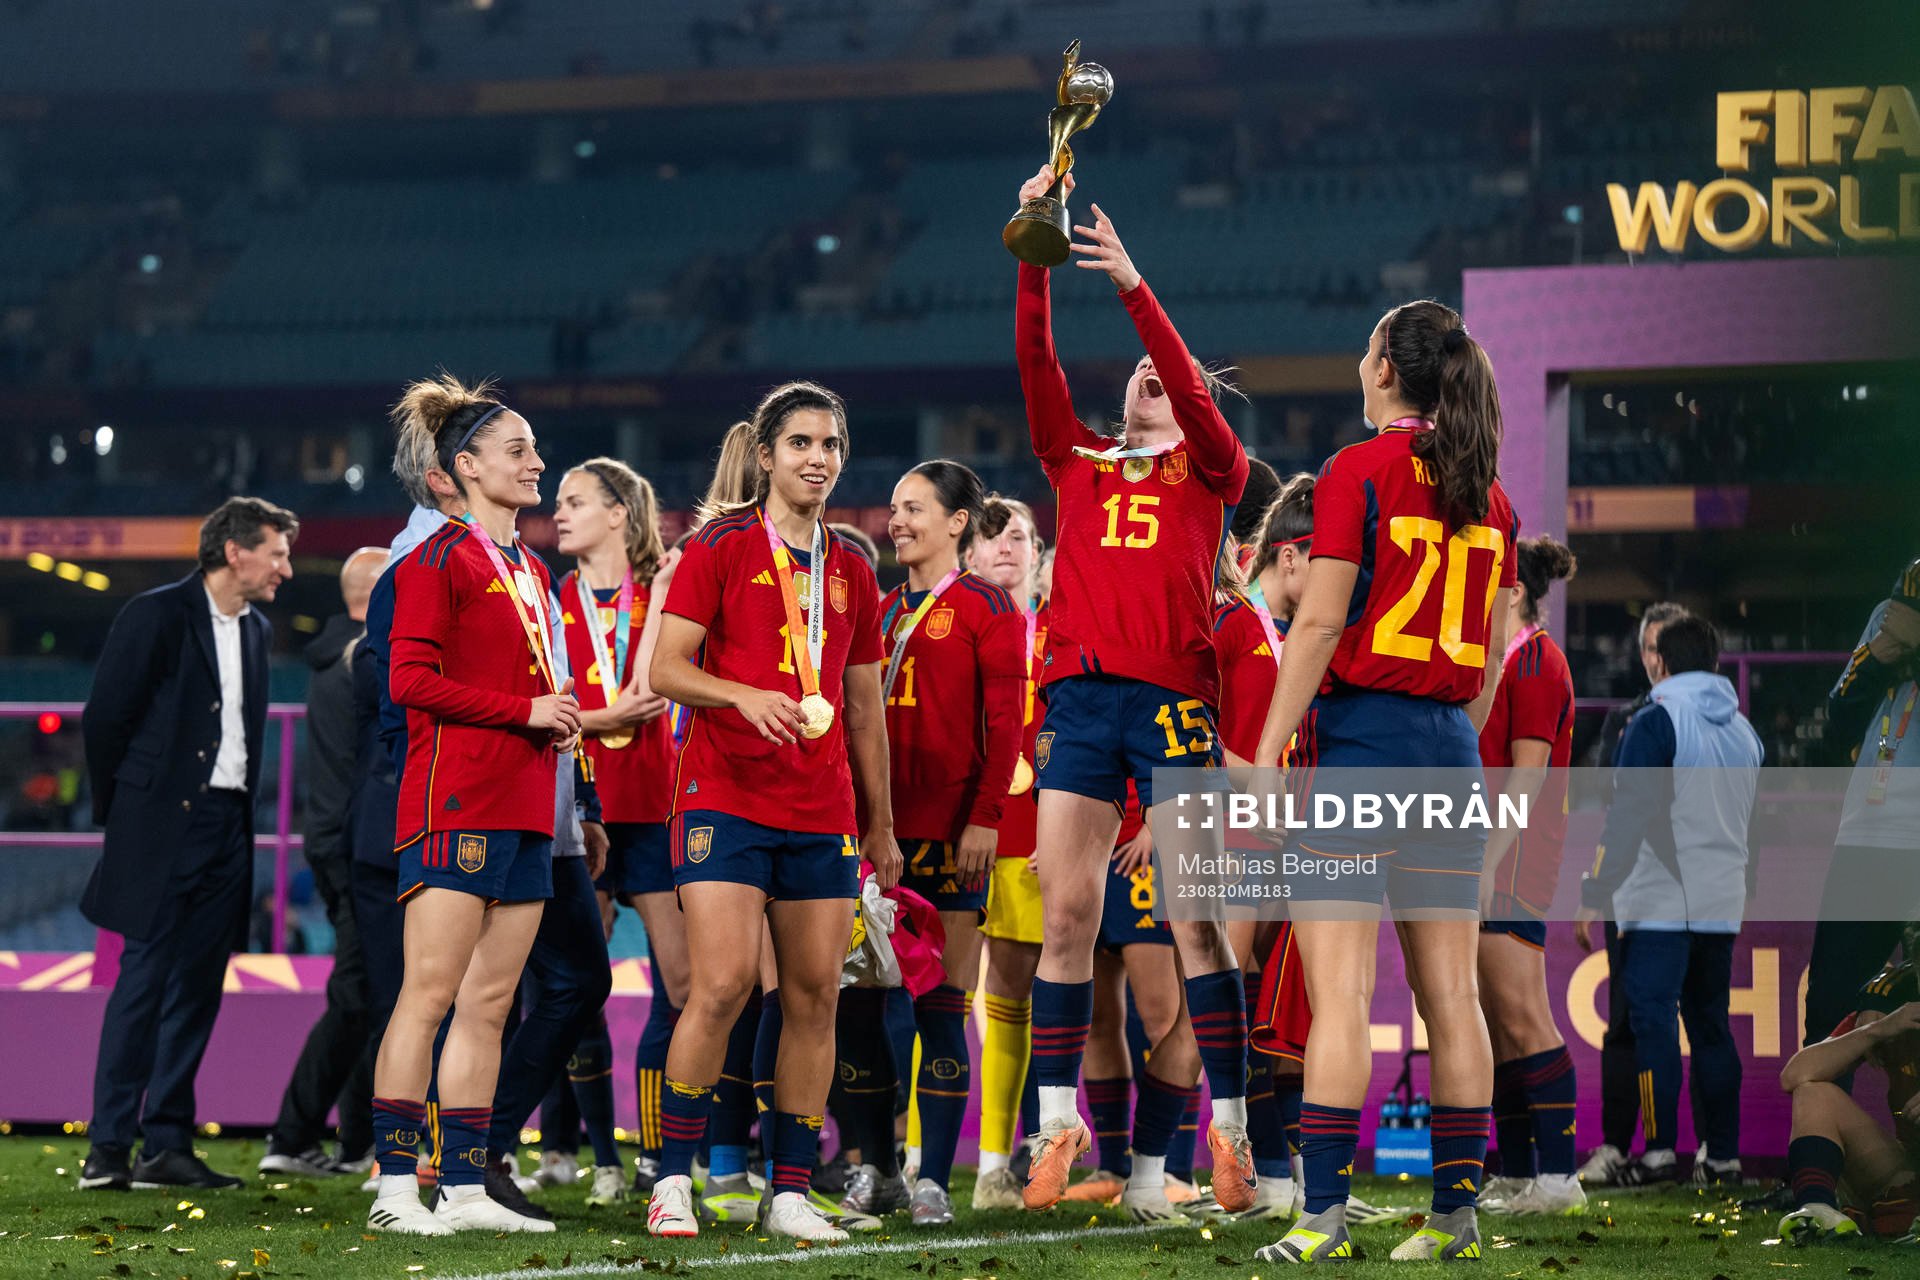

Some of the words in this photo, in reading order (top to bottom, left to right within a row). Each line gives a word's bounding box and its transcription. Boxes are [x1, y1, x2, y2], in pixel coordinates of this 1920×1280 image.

[1717, 85, 1920, 171] FIFA
[1606, 173, 1920, 255] WORL
[1101, 494, 1160, 549] 15
[1372, 516, 1505, 669] 20
[1154, 699, 1214, 759] 15
[1129, 863, 1158, 910] 8
